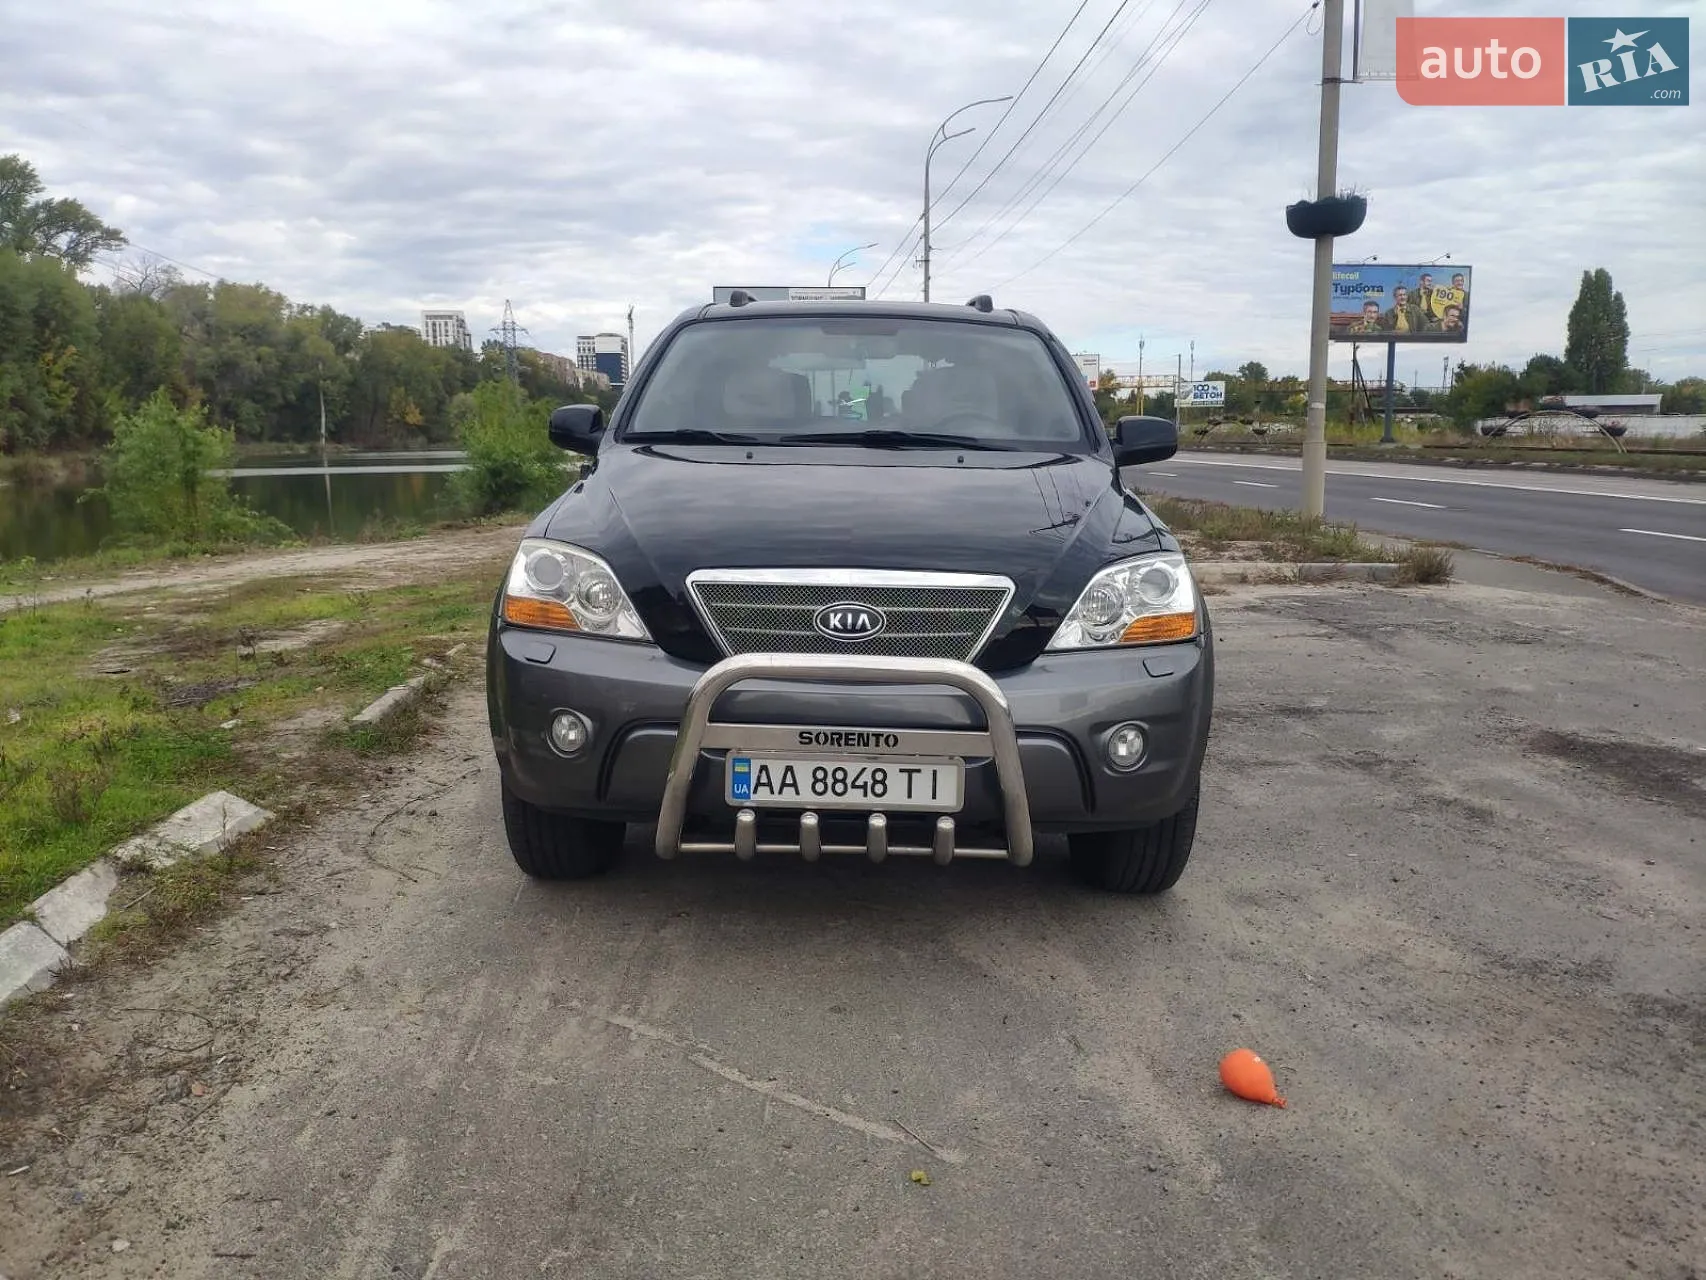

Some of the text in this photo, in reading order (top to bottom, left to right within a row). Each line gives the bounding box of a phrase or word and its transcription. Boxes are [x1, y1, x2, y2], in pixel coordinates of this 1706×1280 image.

[1332, 282, 1384, 296] Турбота
[829, 613, 872, 630] KIA
[798, 731, 899, 748] SORENTO
[734, 784, 749, 794] UA
[752, 764, 801, 797] AA
[810, 766, 888, 799] 8848
